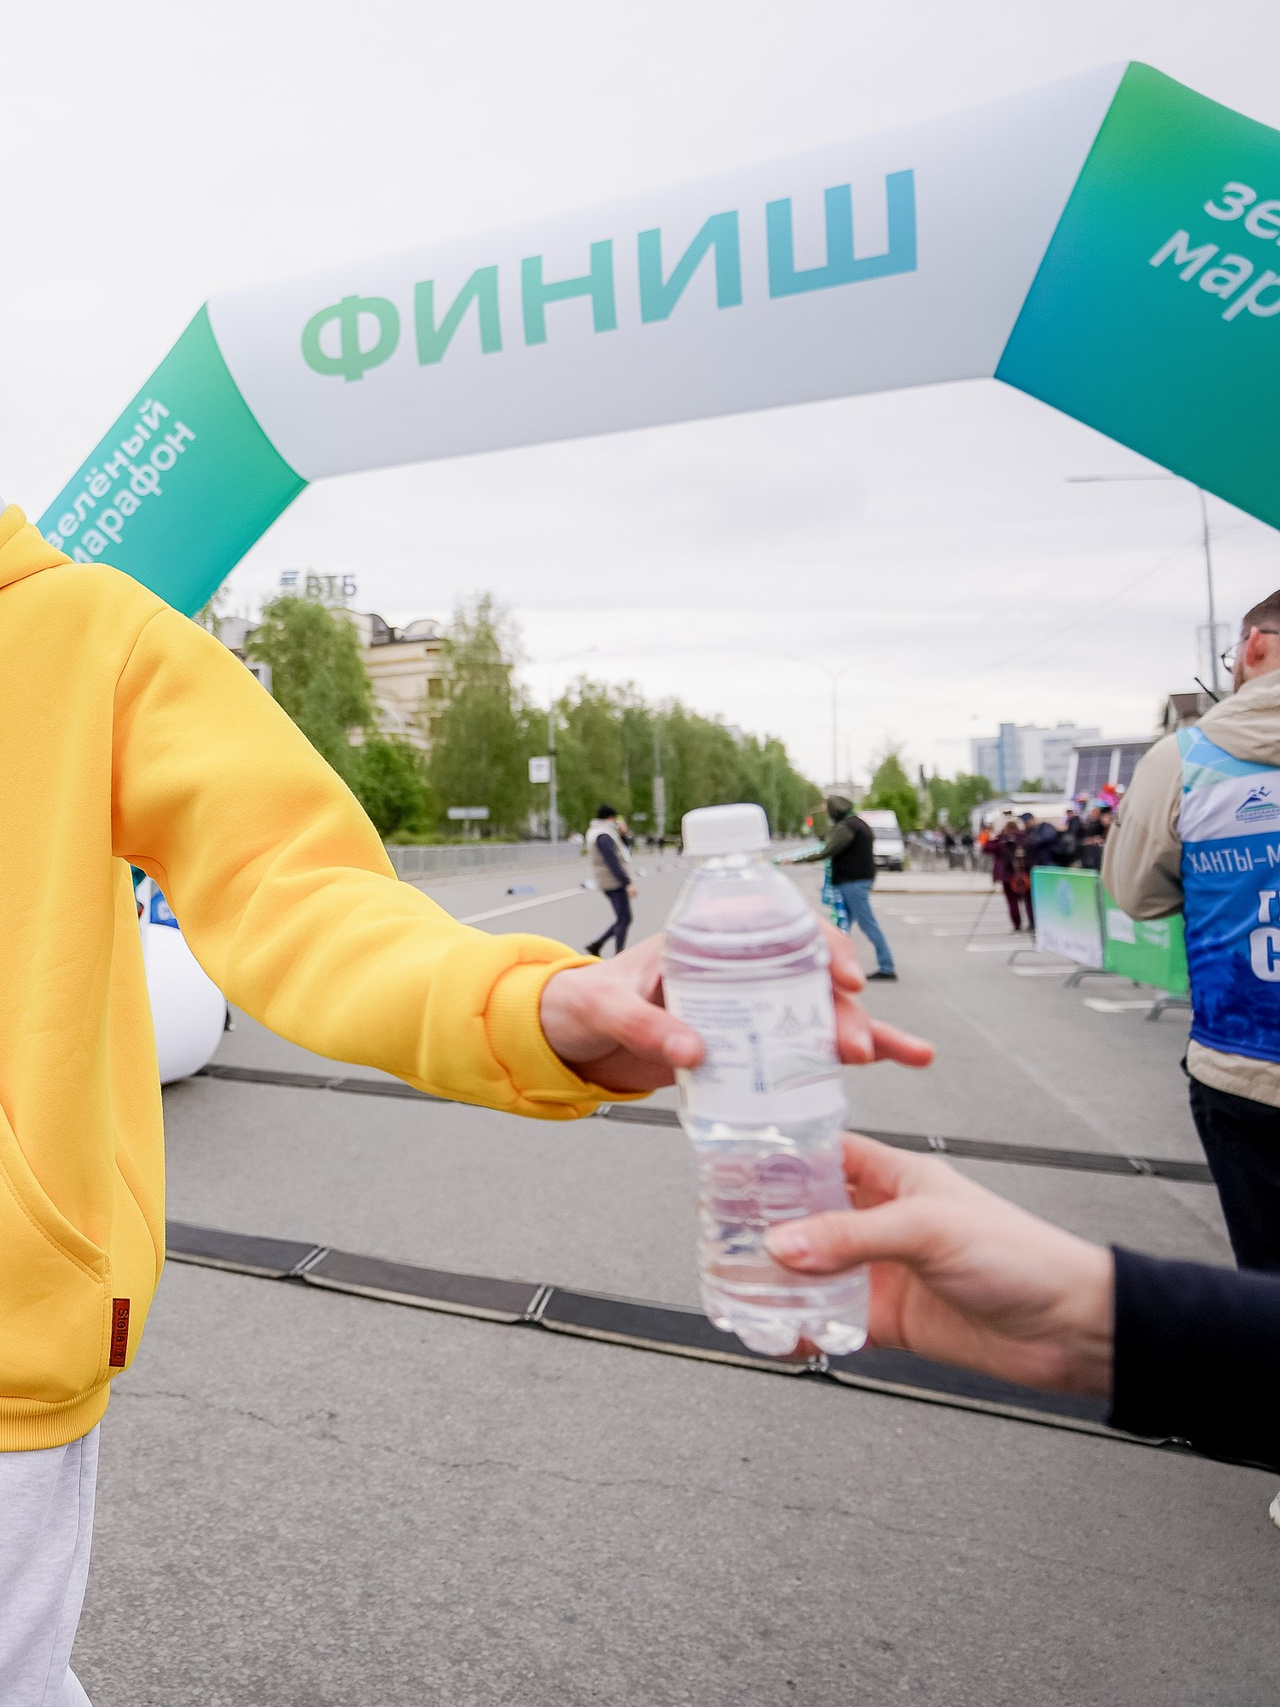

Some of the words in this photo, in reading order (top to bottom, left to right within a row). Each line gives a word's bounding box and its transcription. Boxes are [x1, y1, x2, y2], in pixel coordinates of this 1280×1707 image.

[1203, 181, 1280, 247] зе
[300, 168, 918, 383] ФИНИШ
[306, 574, 357, 598] ВТБ
[116, 1308, 129, 1342] Stella
